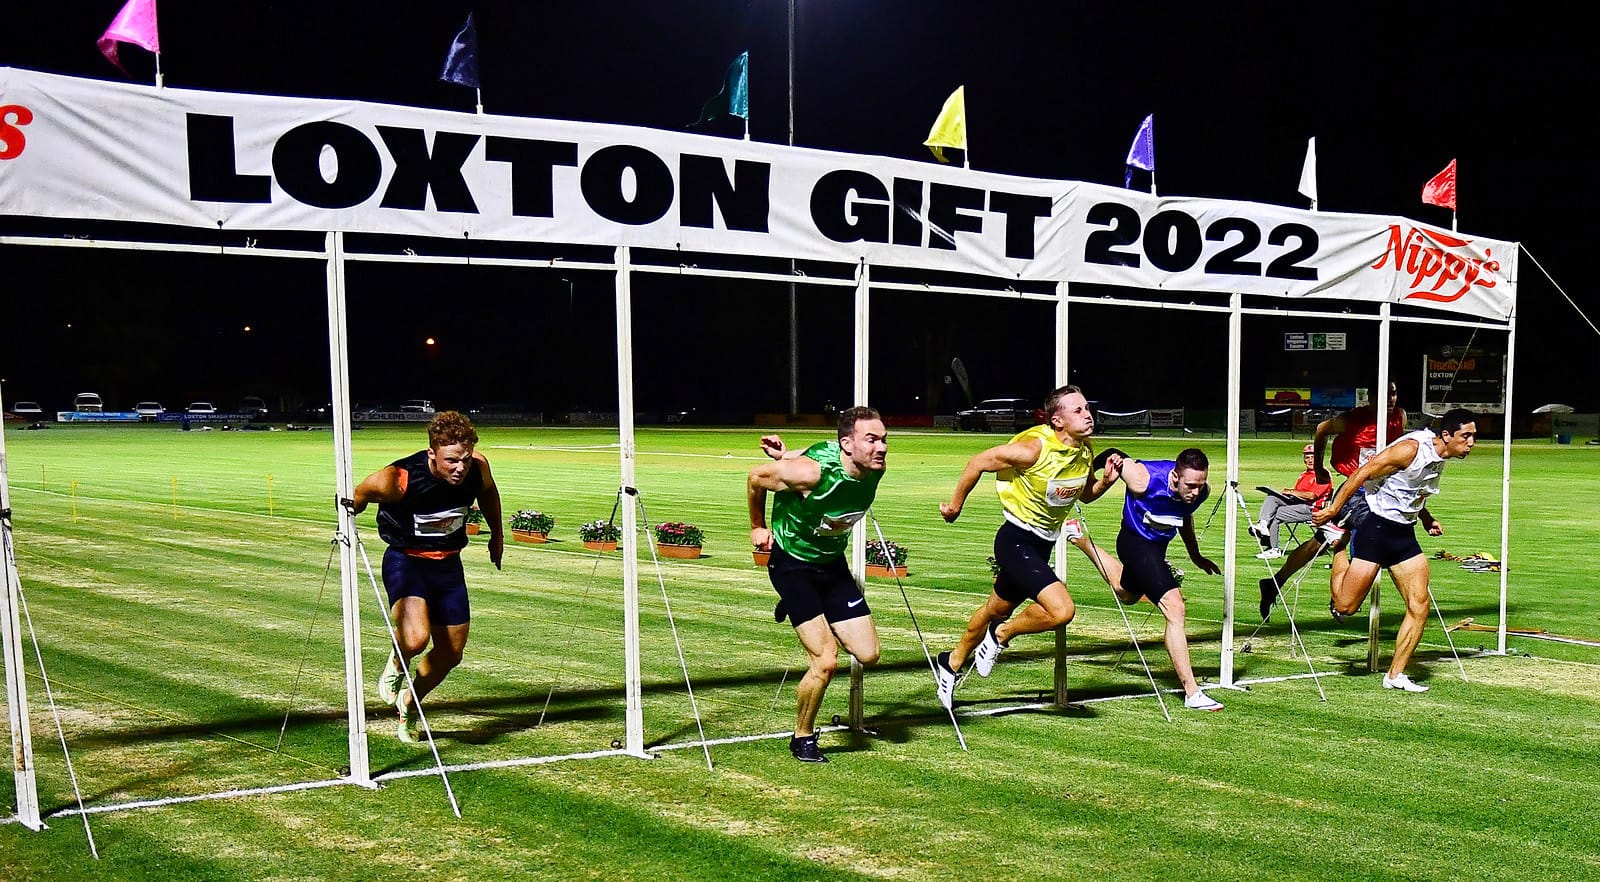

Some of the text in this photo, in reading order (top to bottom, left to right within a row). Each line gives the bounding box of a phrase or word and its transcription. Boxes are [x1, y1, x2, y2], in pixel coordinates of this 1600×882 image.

[186, 113, 1319, 281] LOXTON GIFT 2022
[1372, 225, 1500, 303] Nippy's
